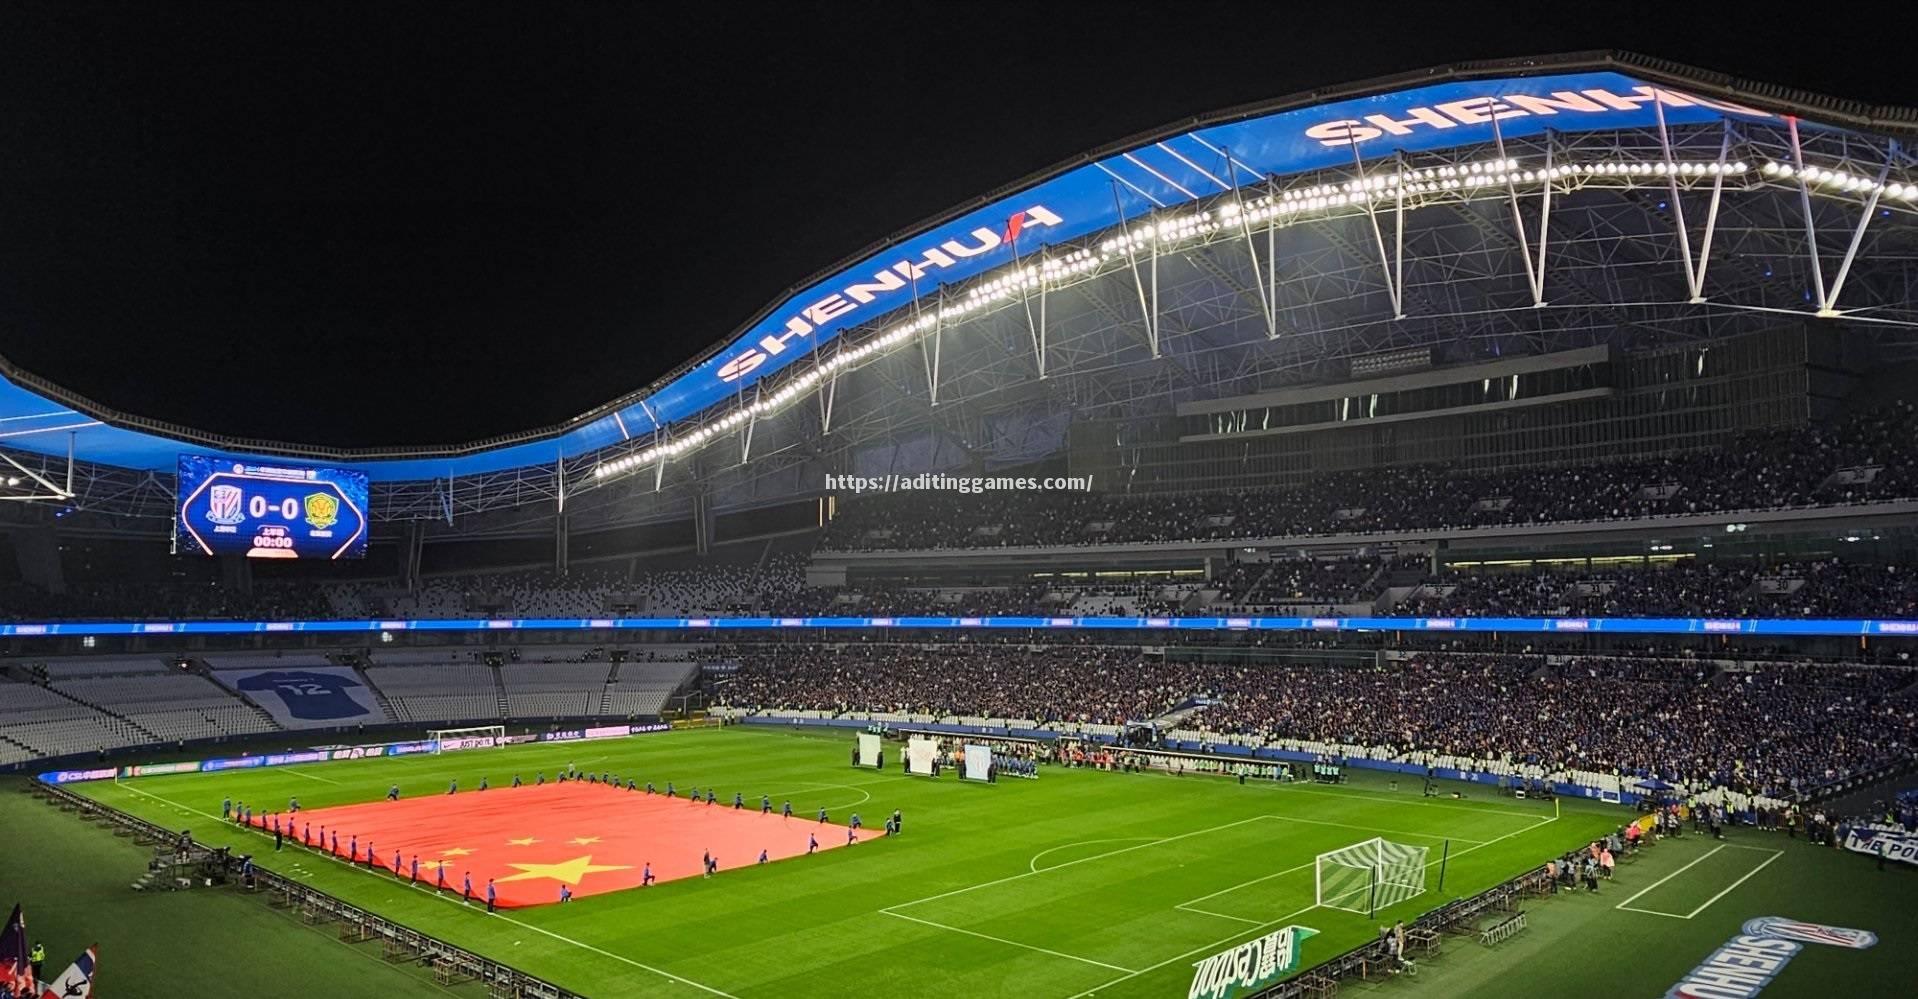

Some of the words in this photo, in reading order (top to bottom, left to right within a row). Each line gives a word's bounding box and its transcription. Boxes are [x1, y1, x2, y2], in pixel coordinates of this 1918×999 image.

[717, 205, 1063, 383] SHENHUA
[253, 536, 293, 548] 00:00
[278, 684, 332, 696] 12
